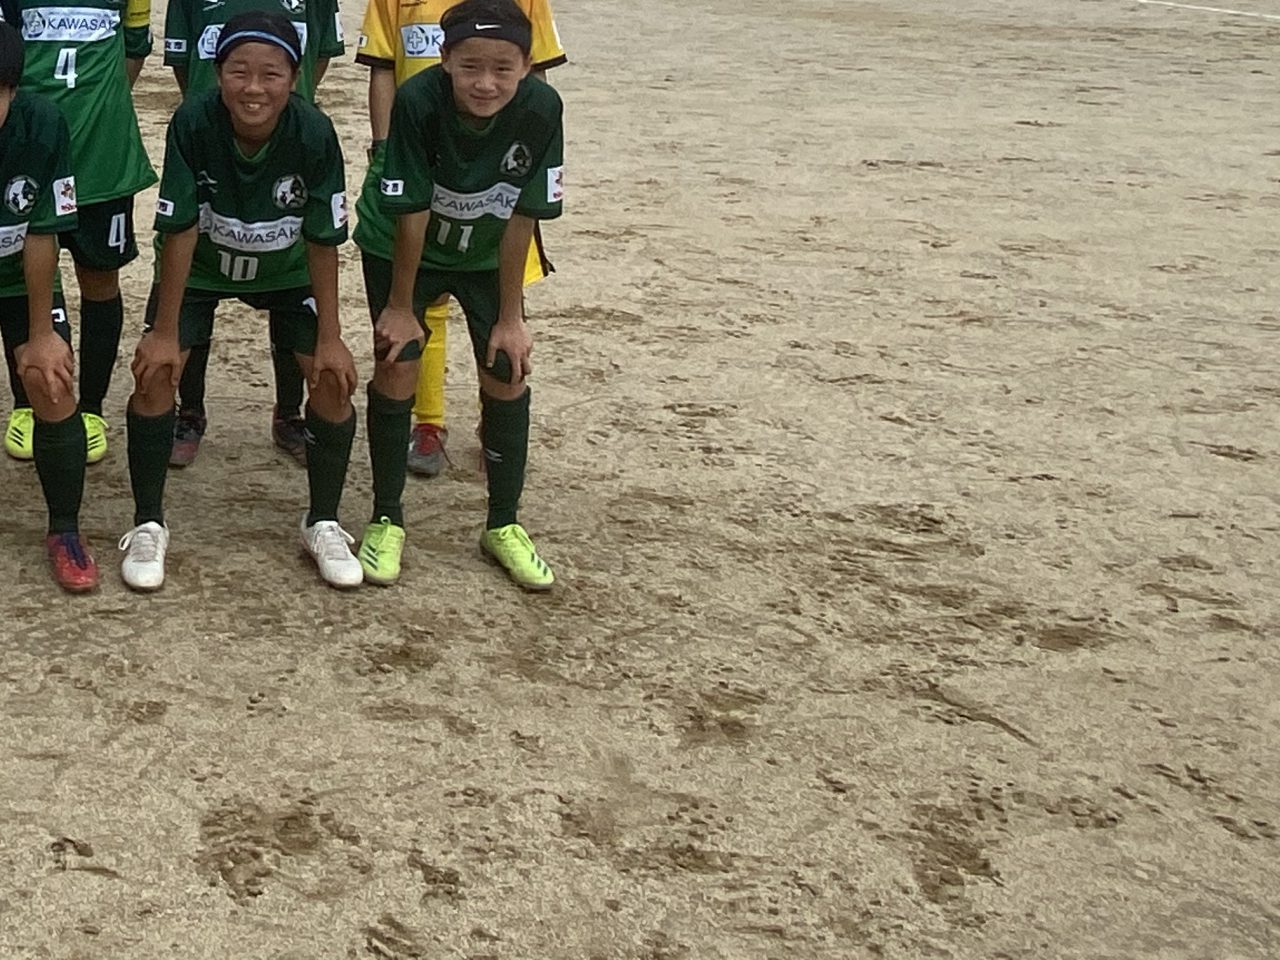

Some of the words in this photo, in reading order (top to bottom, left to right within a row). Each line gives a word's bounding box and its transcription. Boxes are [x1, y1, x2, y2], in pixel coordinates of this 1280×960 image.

[54, 48, 78, 88] 4
[108, 213, 126, 254] 4
[437, 219, 475, 253] 11
[218, 250, 259, 281] 10
